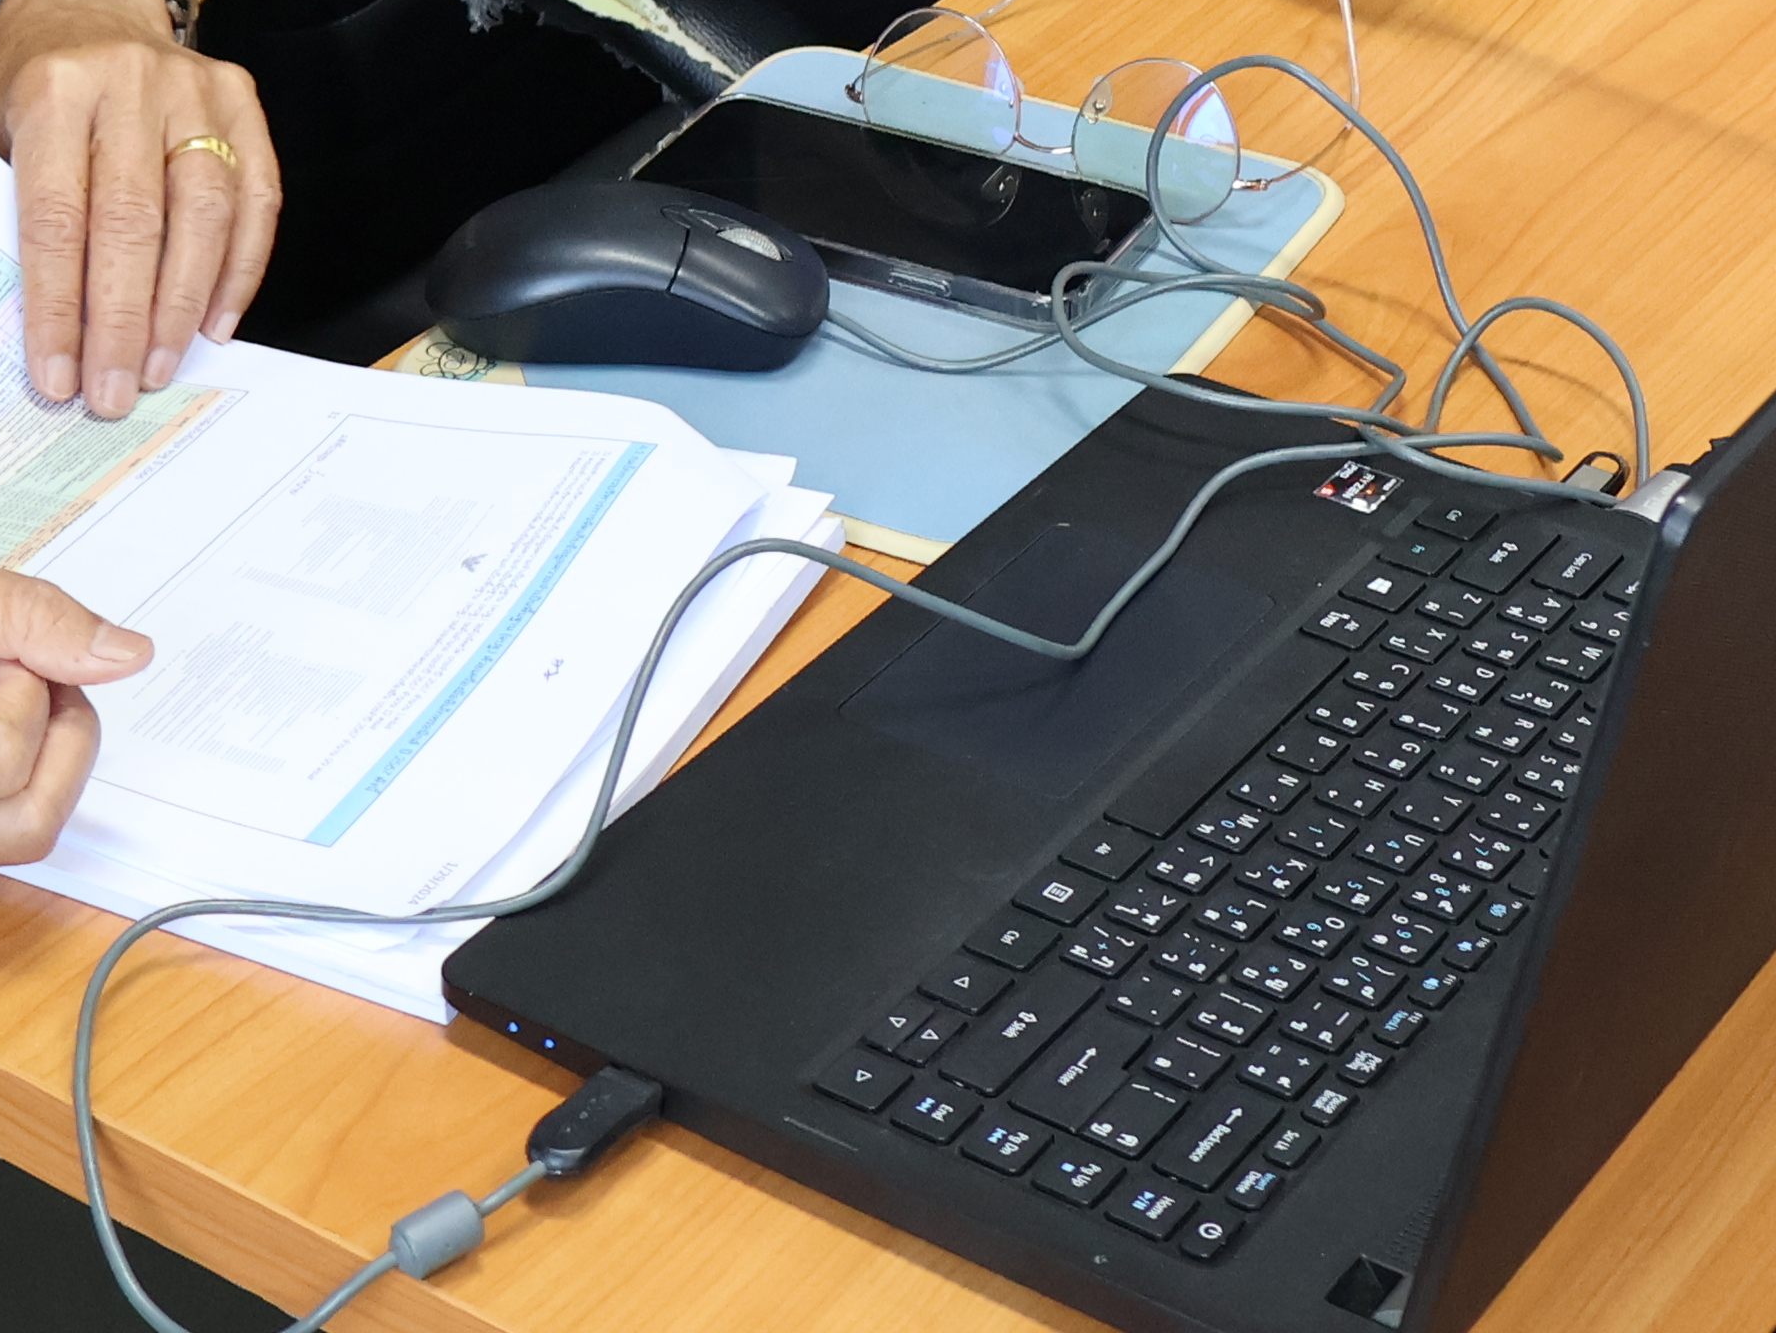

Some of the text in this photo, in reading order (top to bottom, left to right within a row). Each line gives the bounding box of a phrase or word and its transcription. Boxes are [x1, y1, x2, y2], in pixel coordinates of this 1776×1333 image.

[1462, 592, 1483, 605] Z
[1542, 597, 1561, 608] A
[1426, 628, 1447, 641] X
[1510, 631, 1529, 643] S
[1581, 646, 1604, 661] W
[1391, 663, 1410, 675] C
[1475, 667, 1495, 679] D
[1550, 680, 1570, 692] E
[1355, 700, 1375, 713] V
[1442, 703, 1460, 715] F
[1514, 717, 1535, 729] R
[1318, 735, 1338, 748] B
[1401, 742, 1421, 754] G
[1480, 756, 1500, 768] T
[1540, 754, 1557, 765] 5
[1277, 773, 1299, 787] N
[1364, 779, 1386, 792] H
[1443, 795, 1463, 807] Y
[1504, 792, 1522, 804] 6
[1236, 813, 1260, 829] M
[1404, 834, 1425, 847] U
[1468, 832, 1486, 844] 7
[1285, 858, 1308, 872] K
[406, 859, 458, 909] 1/29/2024
[1429, 873, 1447, 884] 8
[1391, 913, 1409, 925] 9
[1288, 958, 1307, 971] P
[930, 1103, 954, 1122] End
[999, 1131, 1030, 1156] Pg Dn
[1188, 1123, 1232, 1163] Backspace
[1070, 1163, 1102, 1188] Pg Up
[1145, 1195, 1176, 1220] Home
